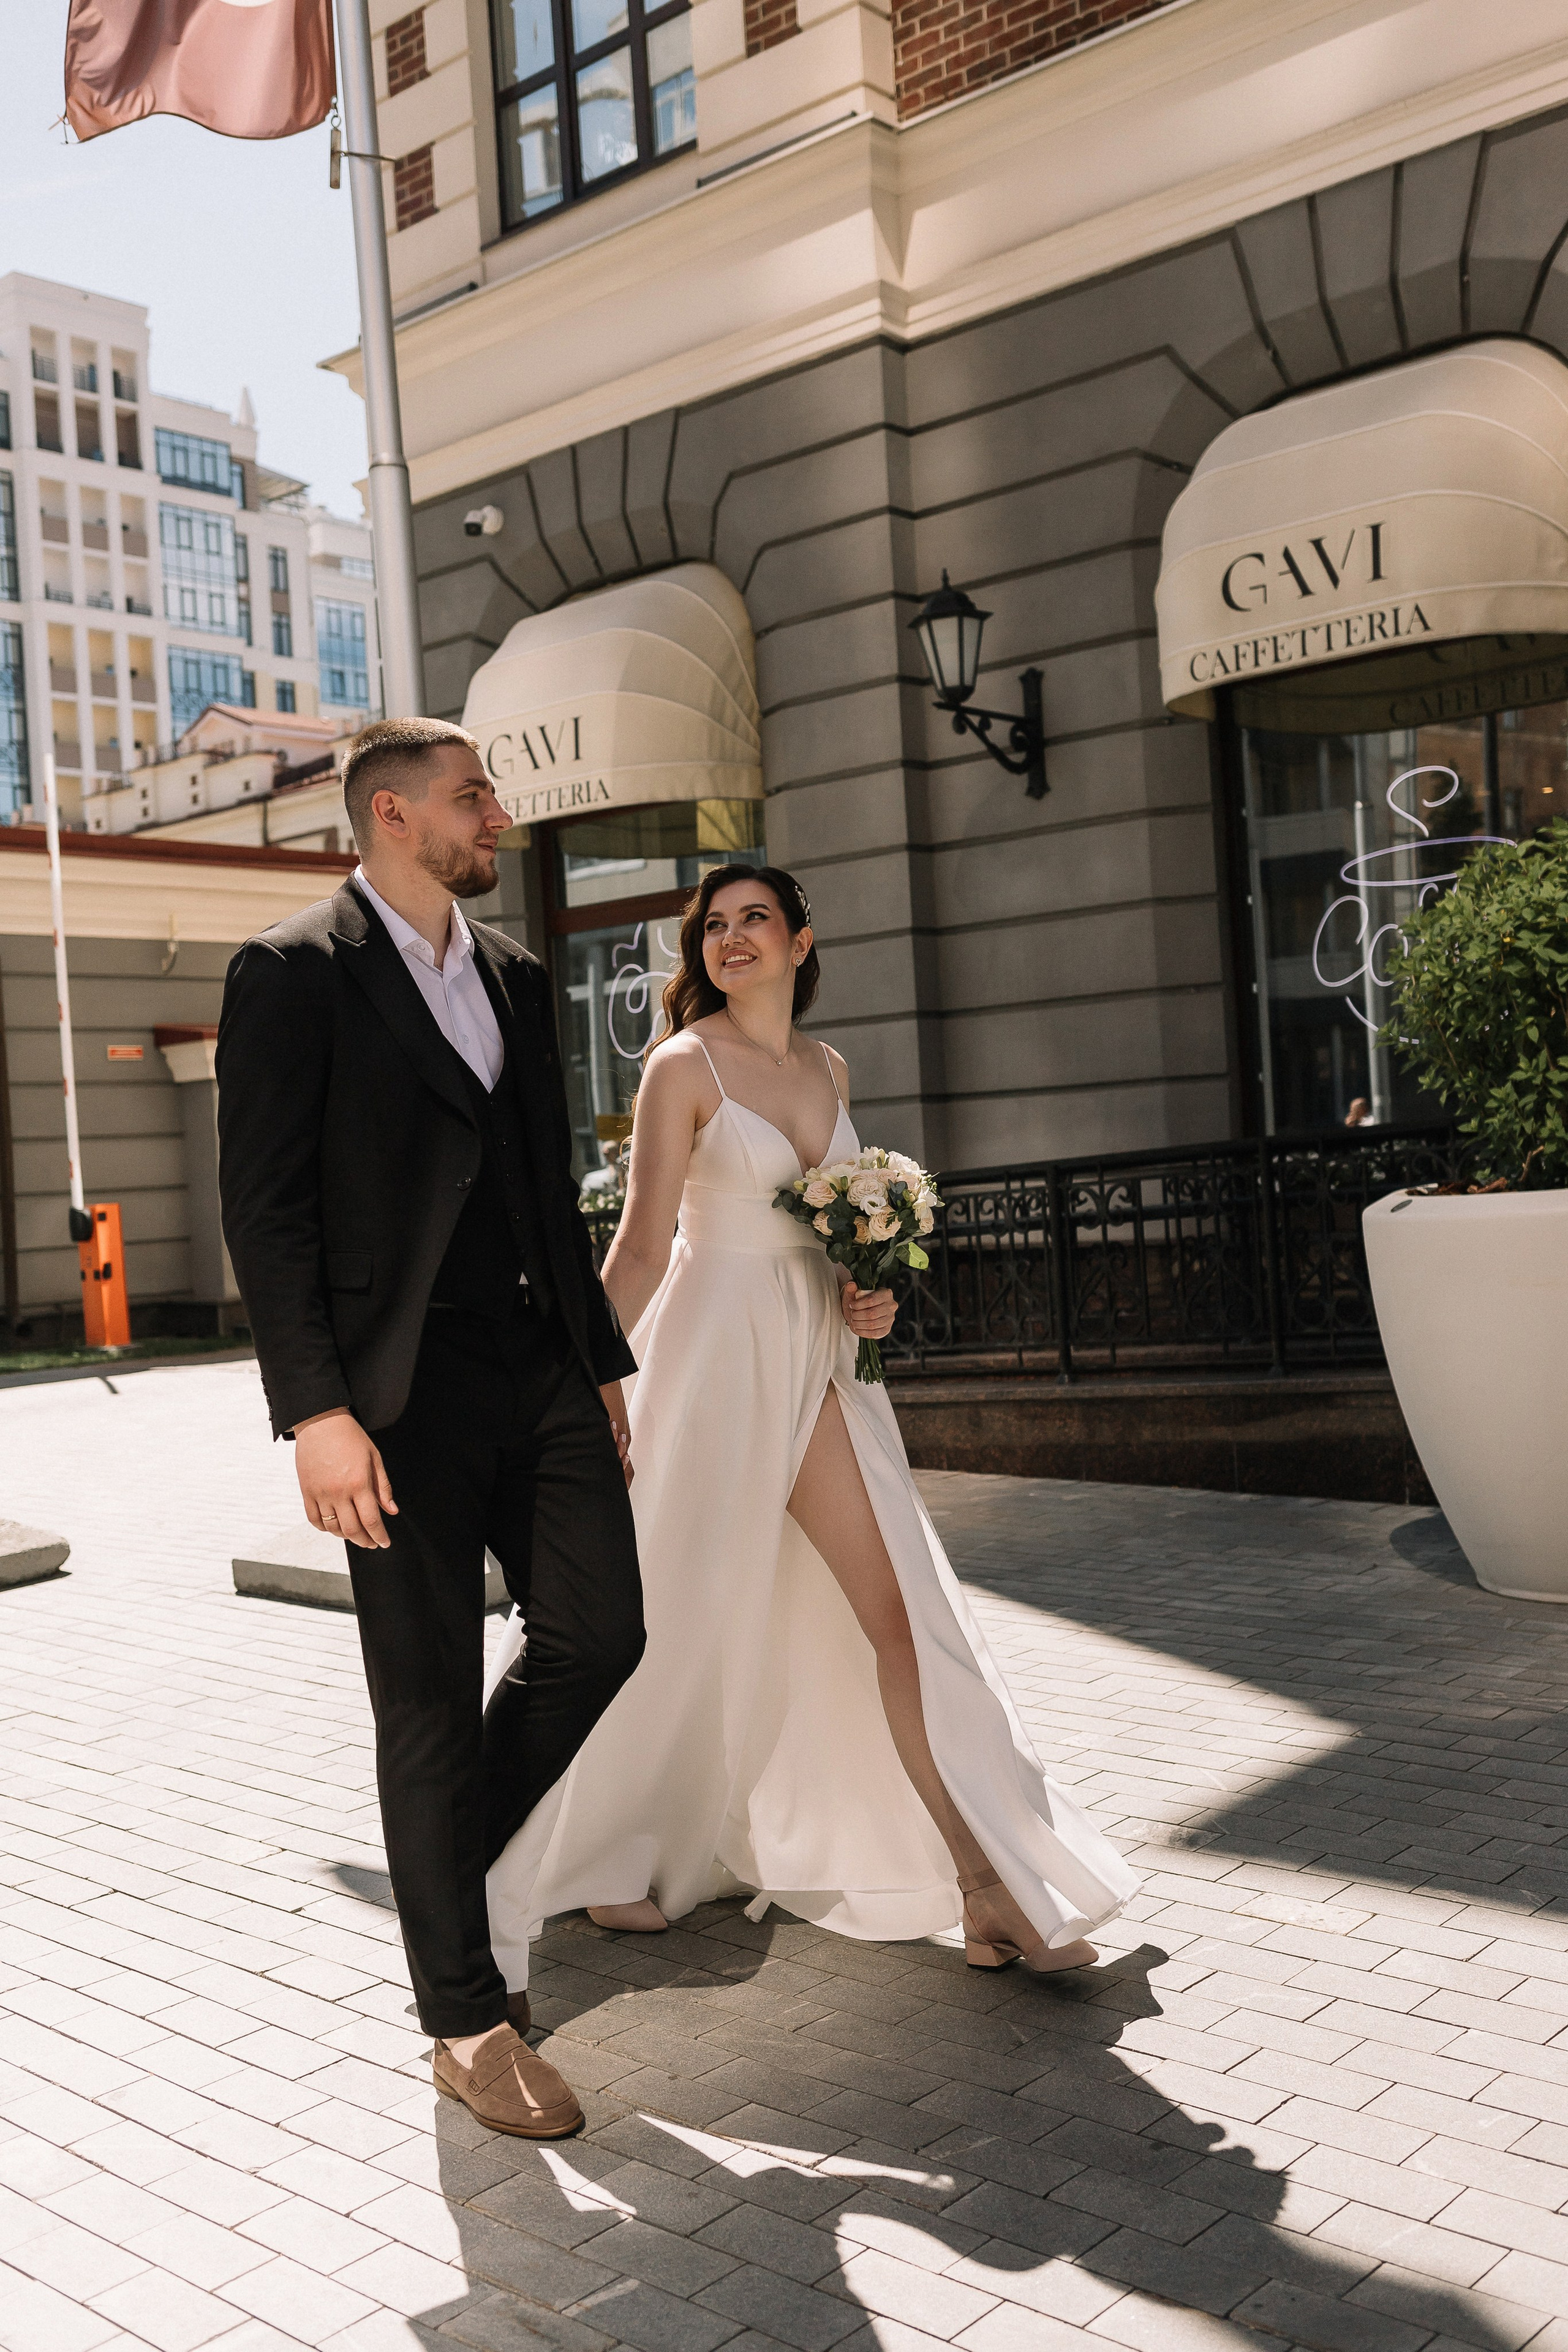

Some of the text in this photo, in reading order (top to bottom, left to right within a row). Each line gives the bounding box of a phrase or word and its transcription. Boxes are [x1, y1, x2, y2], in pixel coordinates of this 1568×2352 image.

[1221, 521, 1387, 612] GAVI
[1188, 603, 1433, 683] CAFFETTERIA
[488, 717, 581, 778] GAVI
[499, 778, 610, 818] FETTERIA
